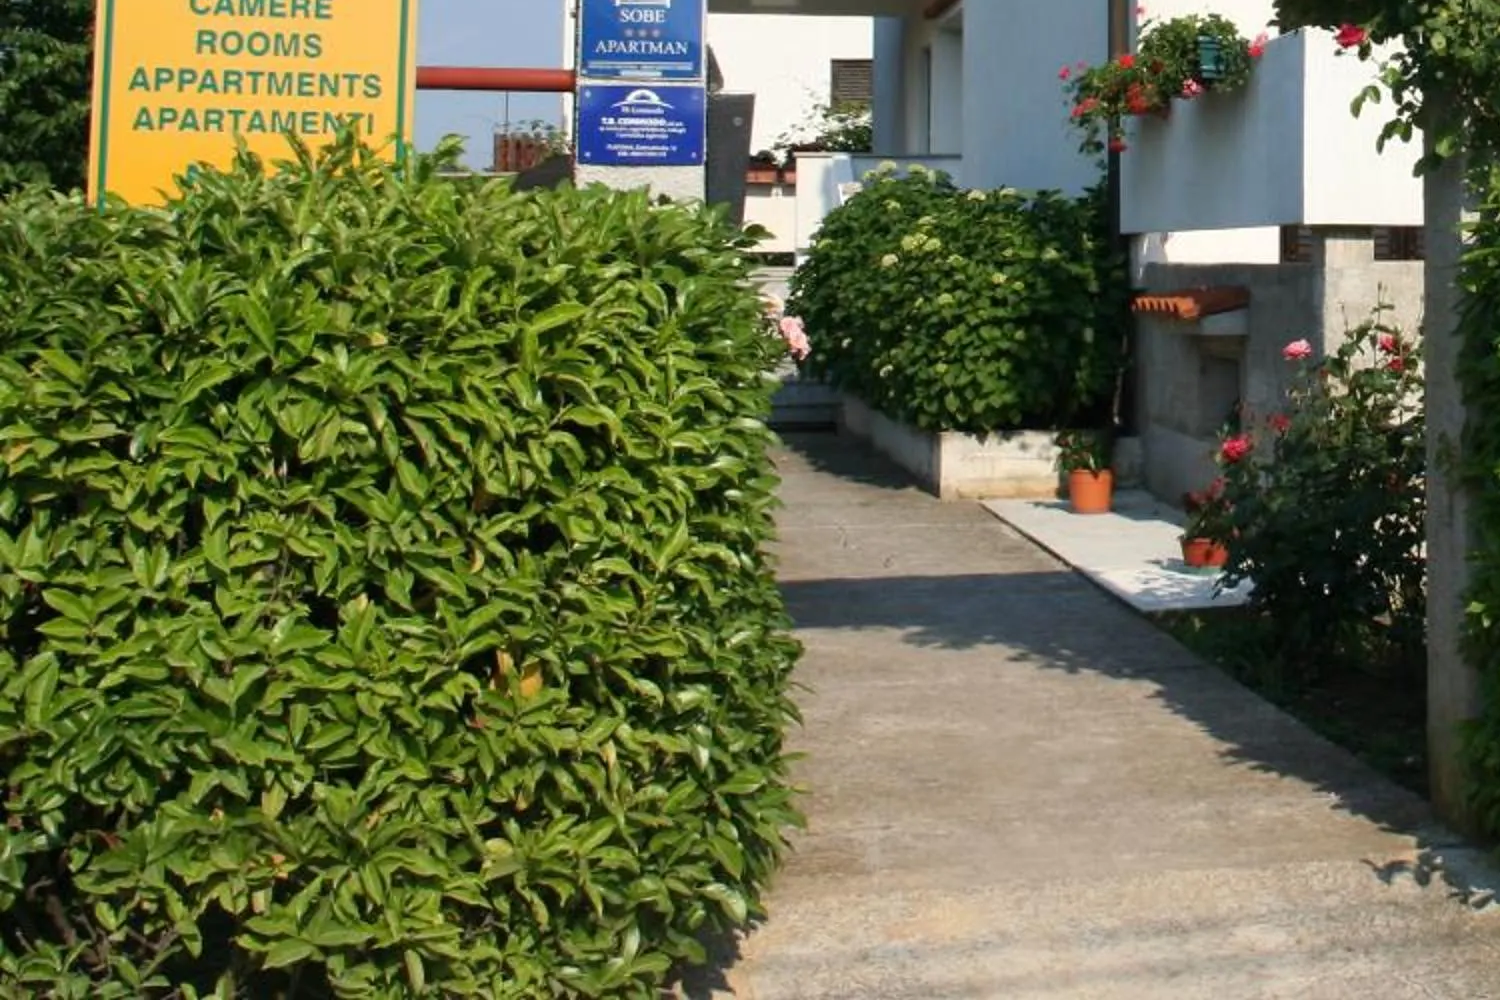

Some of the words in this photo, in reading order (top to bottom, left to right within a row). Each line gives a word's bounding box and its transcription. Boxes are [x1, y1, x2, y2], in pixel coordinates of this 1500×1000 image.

[619, 9, 667, 24] SOBE
[195, 29, 323, 58] ROOMS
[595, 40, 688, 55] APARTMAN
[128, 66, 382, 99] APPARTMENTS
